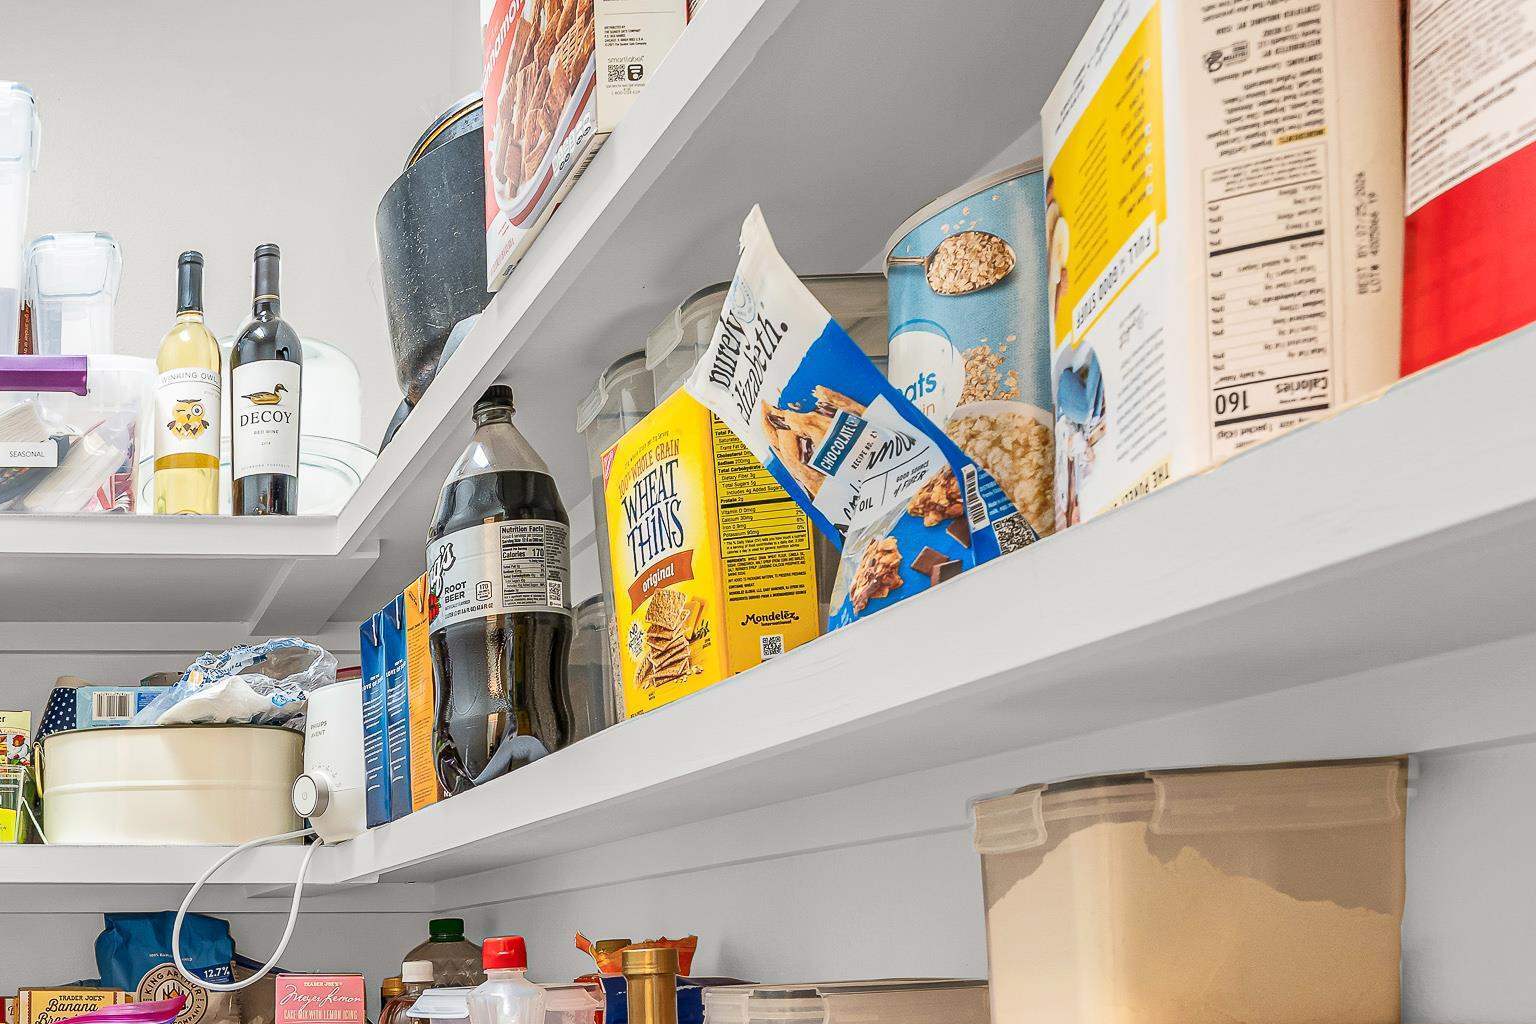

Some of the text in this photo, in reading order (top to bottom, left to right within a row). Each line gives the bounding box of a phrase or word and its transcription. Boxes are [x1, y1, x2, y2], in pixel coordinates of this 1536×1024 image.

[708, 308, 745, 390] purely
[201, 372, 219, 383] OWL
[1215, 376, 1329, 415] Calories 160
[240, 410, 293, 427] DECOY
[9, 449, 45, 459] SEASONAL
[655, 438, 680, 461] GRAIN
[821, 424, 857, 470] CHOCOLATE
[621, 458, 679, 530] WHEAT
[859, 497, 873, 511] OIL
[501, 525, 544, 534] Nutrition Facts
[502, 548, 544, 559] Calories 170
[642, 562, 675, 593] original
[444, 581, 467, 595] ROOT
[445, 591, 465, 604] BEER
[204, 967, 230, 978] 12.7%
[145, 973, 164, 995] KING
[46, 999, 98, 1012] Banana
[280, 984, 362, 1016] Meyer Lemon
